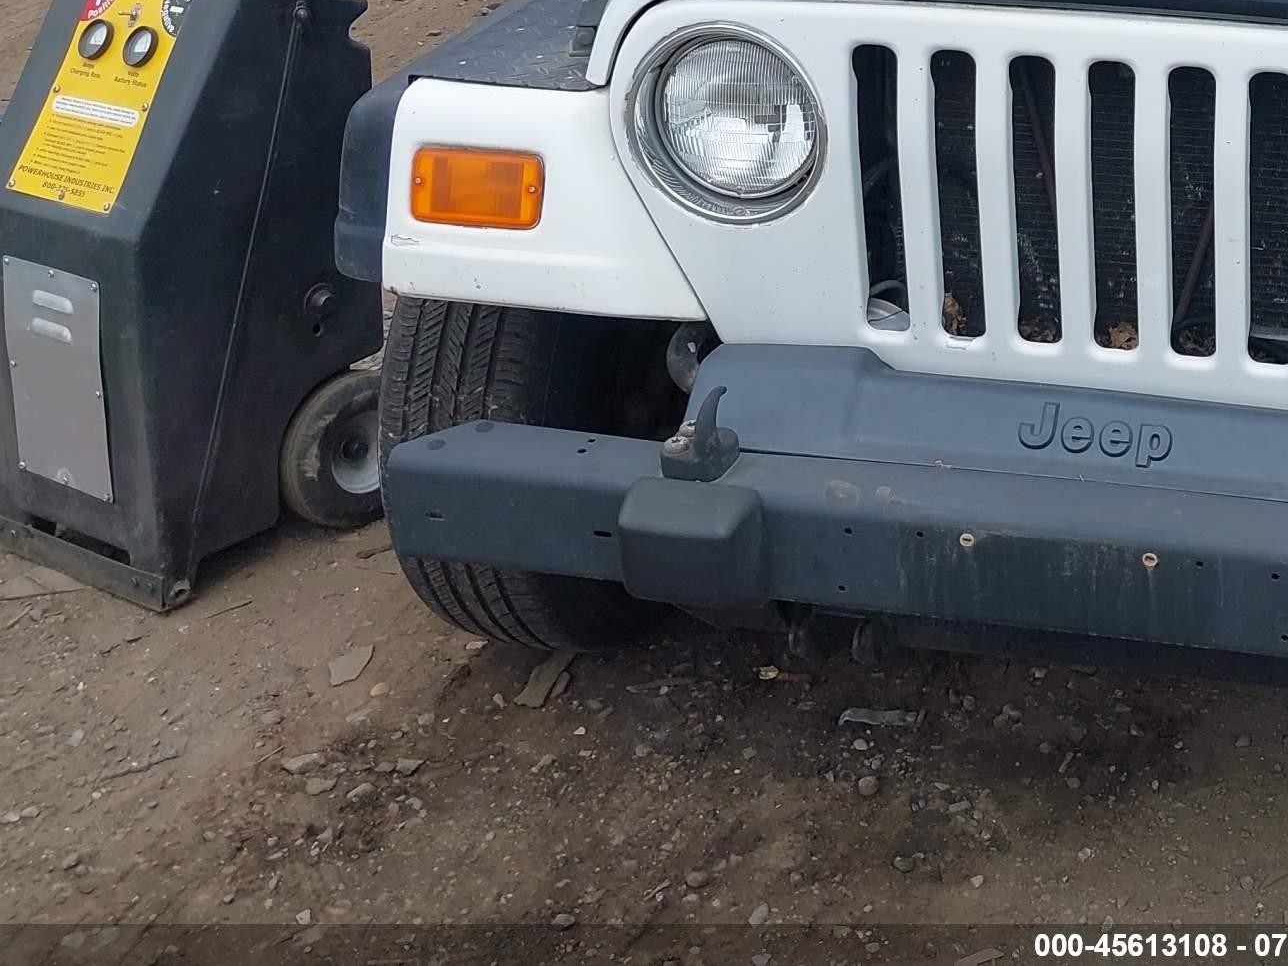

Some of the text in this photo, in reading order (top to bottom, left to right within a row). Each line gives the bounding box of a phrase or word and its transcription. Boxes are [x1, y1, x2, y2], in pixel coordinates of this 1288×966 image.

[17, 164, 64, 183] POWERHOUSE
[63, 174, 104, 191] INDUSTRIES
[1017, 401, 1174, 469] Jeep
